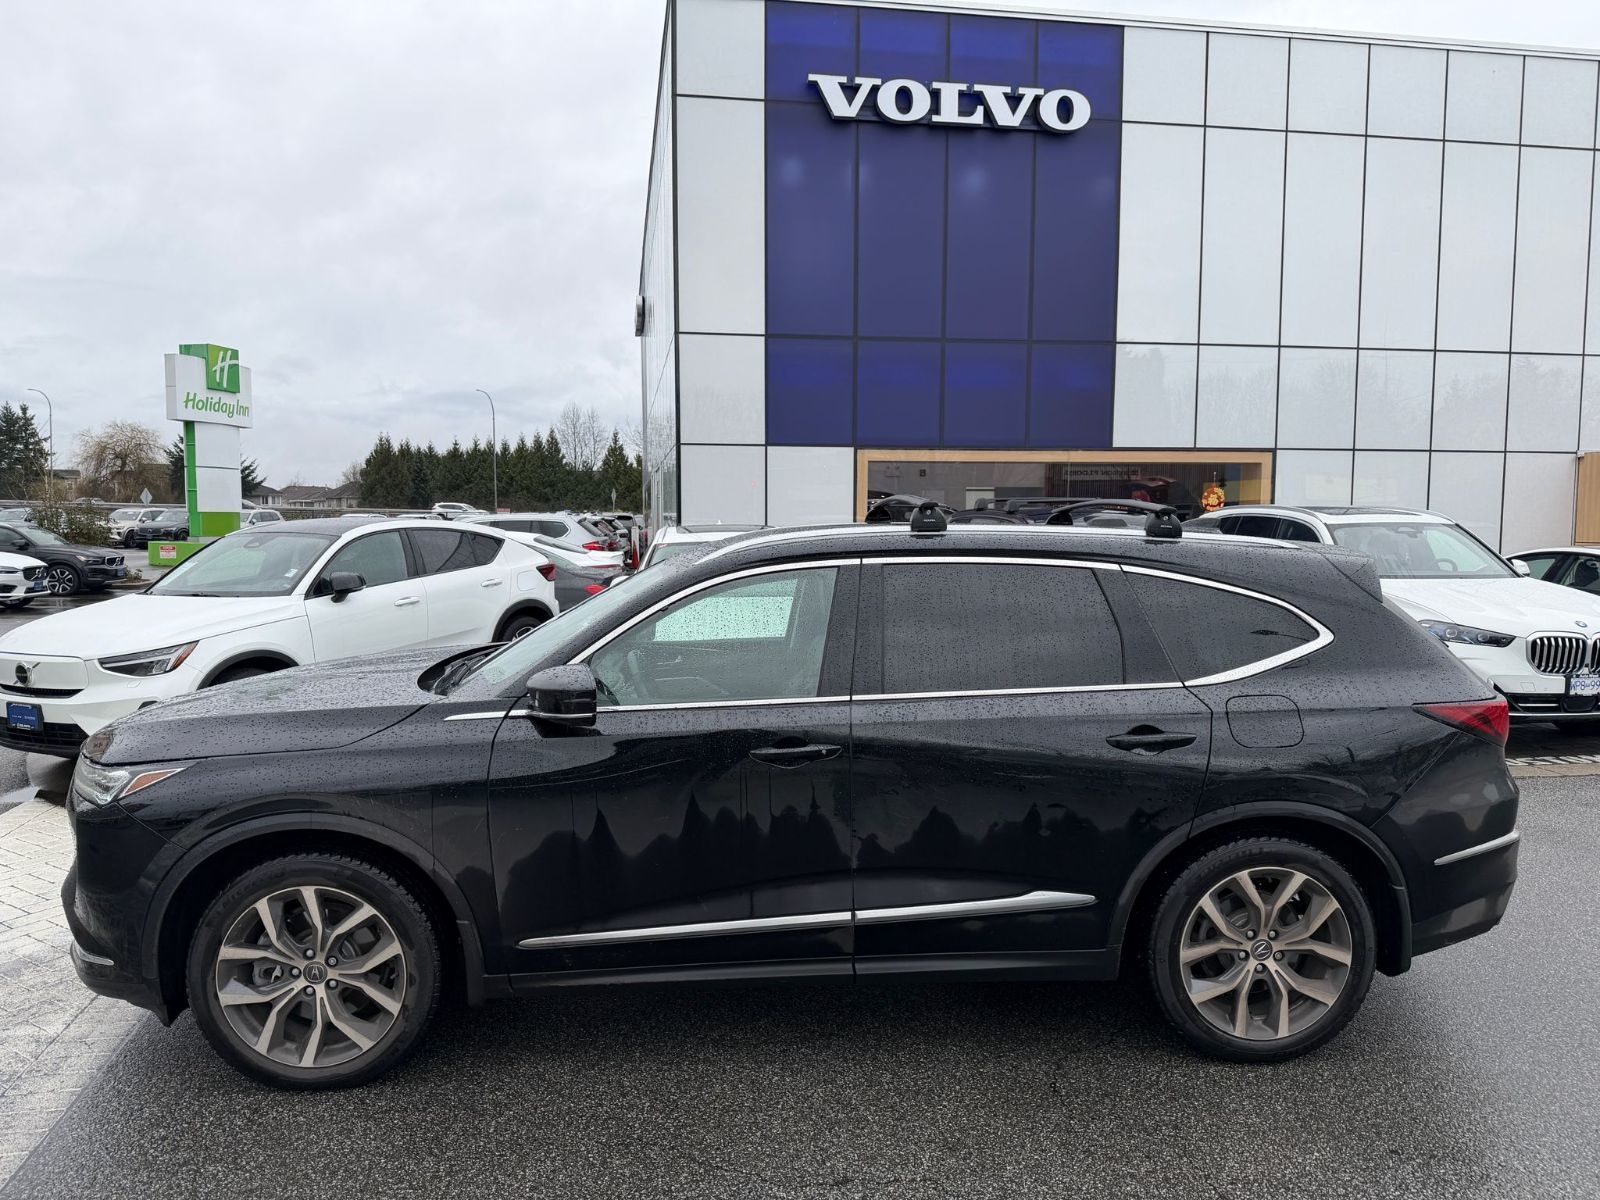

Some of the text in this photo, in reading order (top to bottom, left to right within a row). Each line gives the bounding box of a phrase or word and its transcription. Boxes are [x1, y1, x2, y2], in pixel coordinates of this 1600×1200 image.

[807, 73, 1092, 132] VOLVO
[183, 392, 250, 419] Holiday Inn
